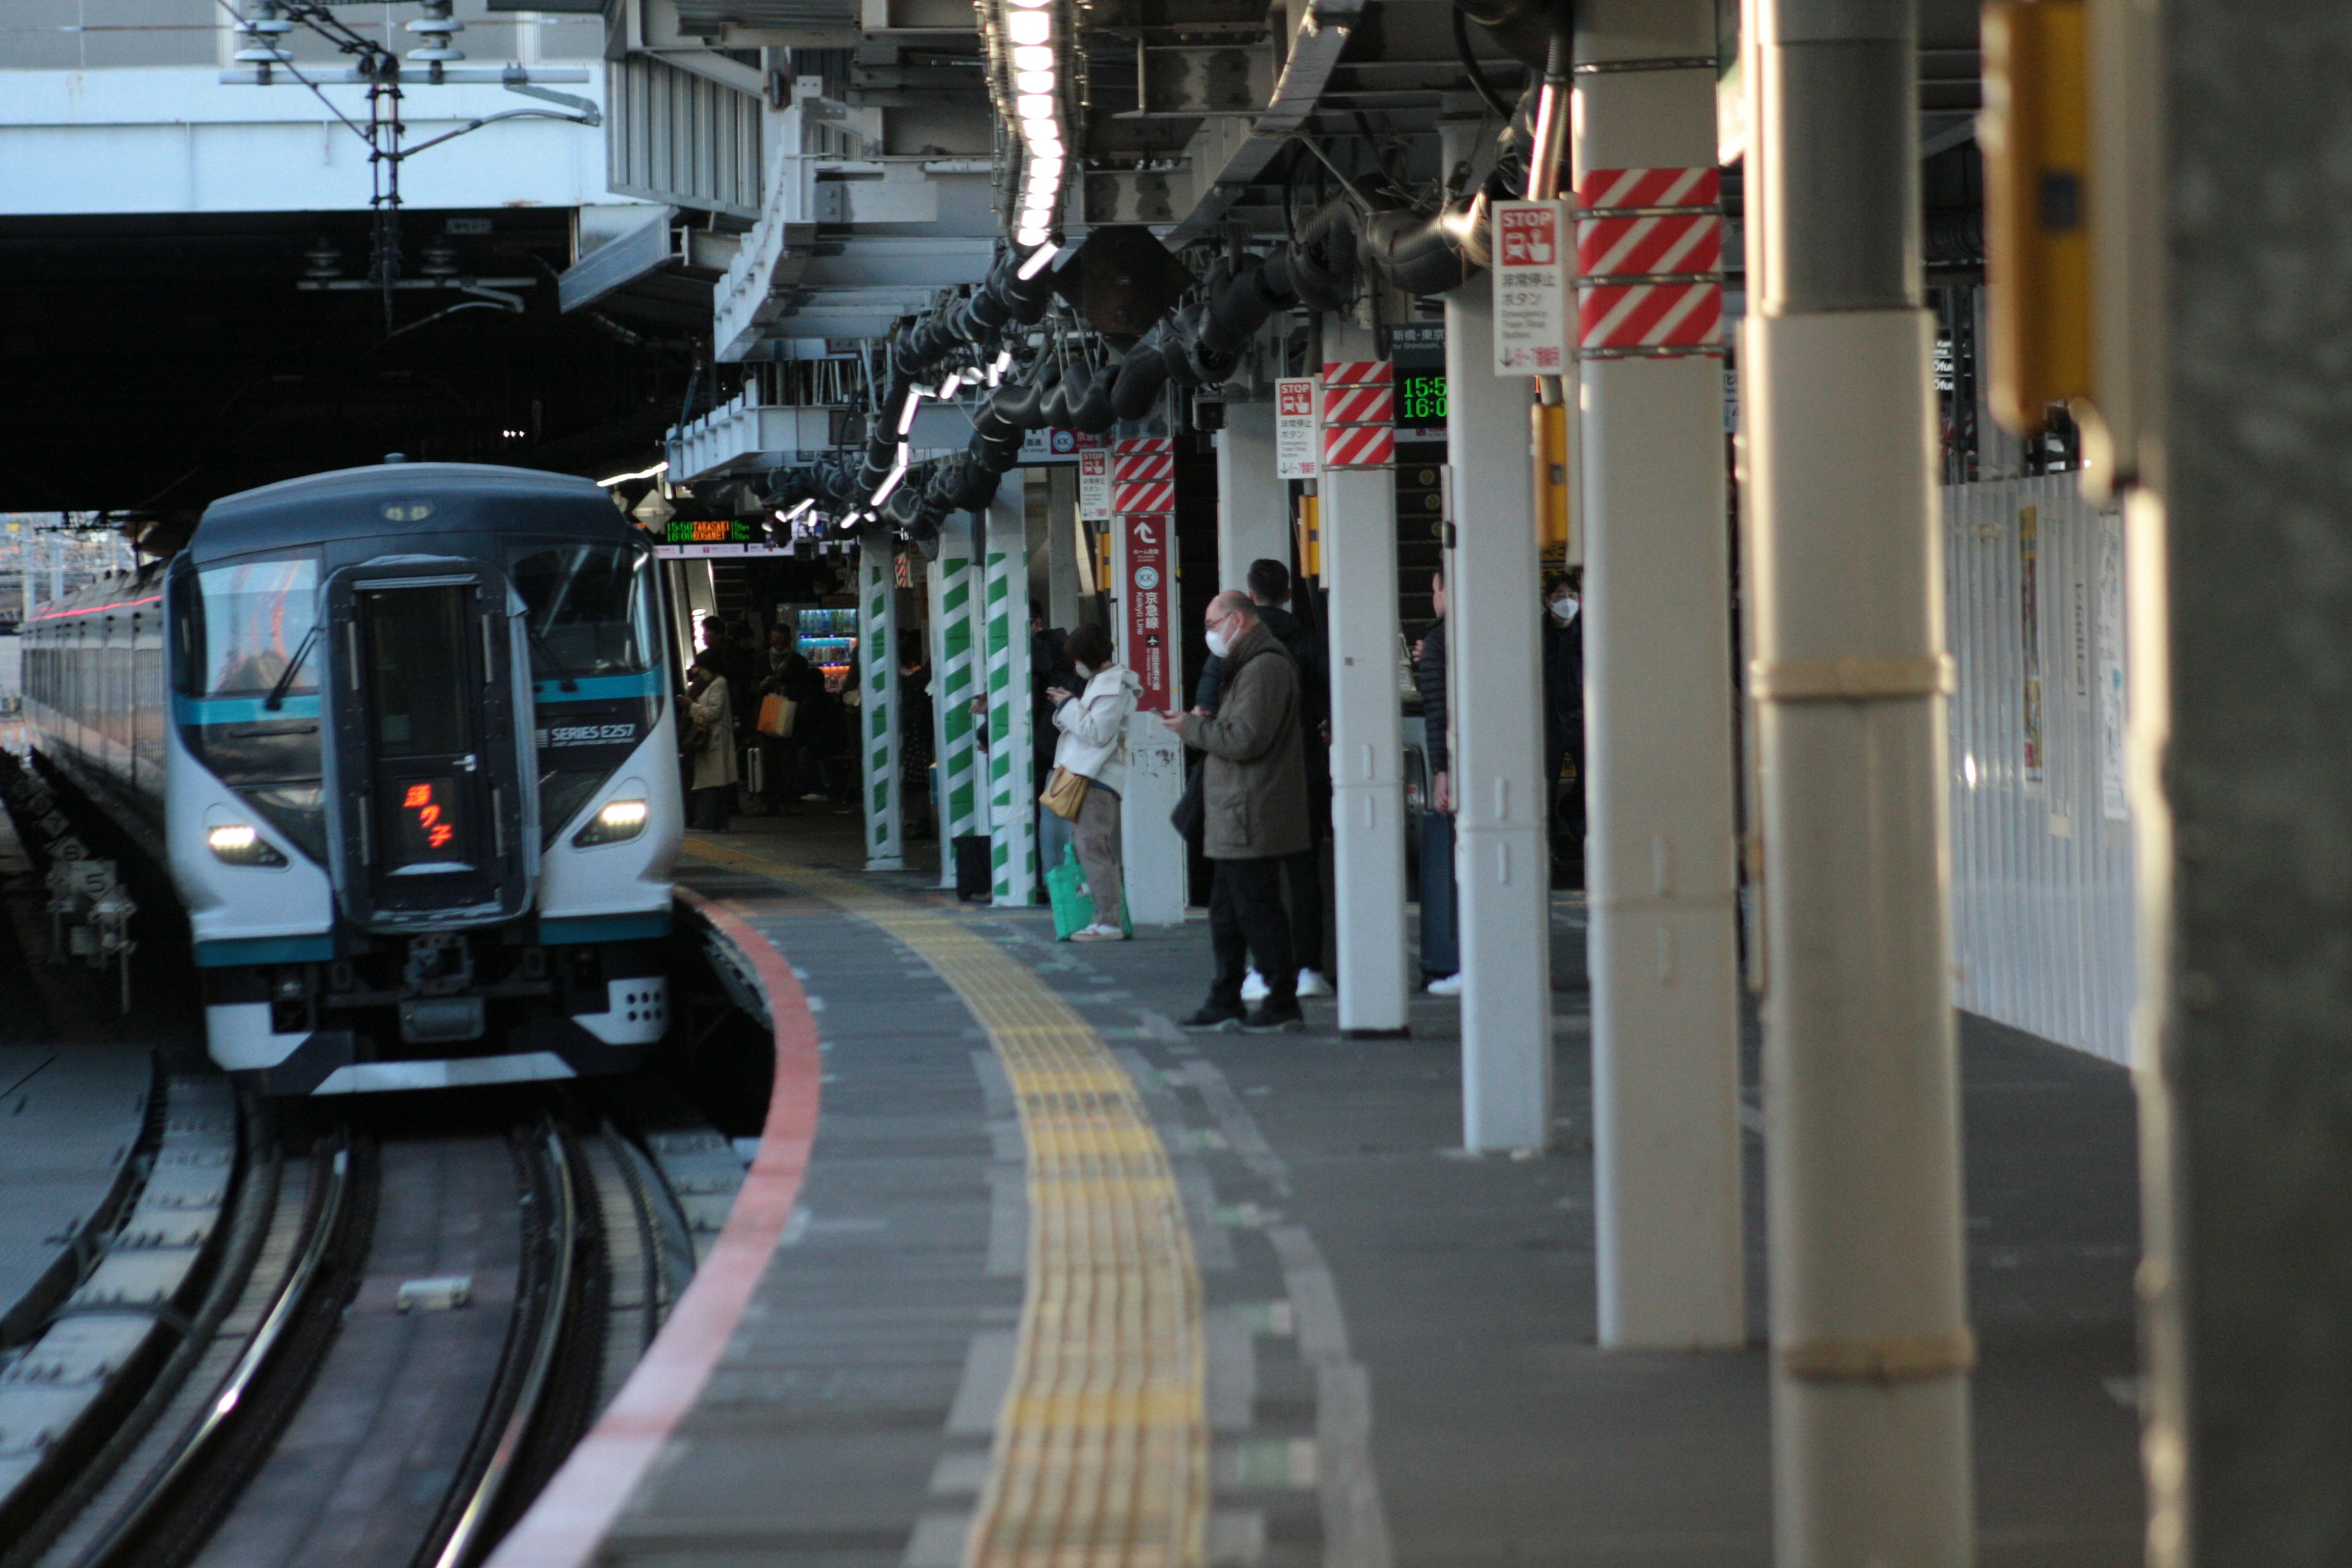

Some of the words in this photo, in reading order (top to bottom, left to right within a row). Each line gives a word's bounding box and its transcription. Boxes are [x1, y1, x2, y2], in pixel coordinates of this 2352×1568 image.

[1503, 211, 1552, 227] STOP
[1501, 272, 1556, 287] 非常停止
[1501, 293, 1542, 306] ボタン
[1281, 384, 1310, 393] STOP
[1404, 377, 1448, 398] 15:5
[1404, 398, 1448, 418] 16:0
[1281, 419, 1312, 428] 非常停止
[693, 521, 730, 531] TAKASAKI
[693, 530, 726, 540] KOGANEI
[1145, 592, 1158, 629] 京急線
[552, 726, 598, 740] SERIES
[601, 724, 635, 737] E257
